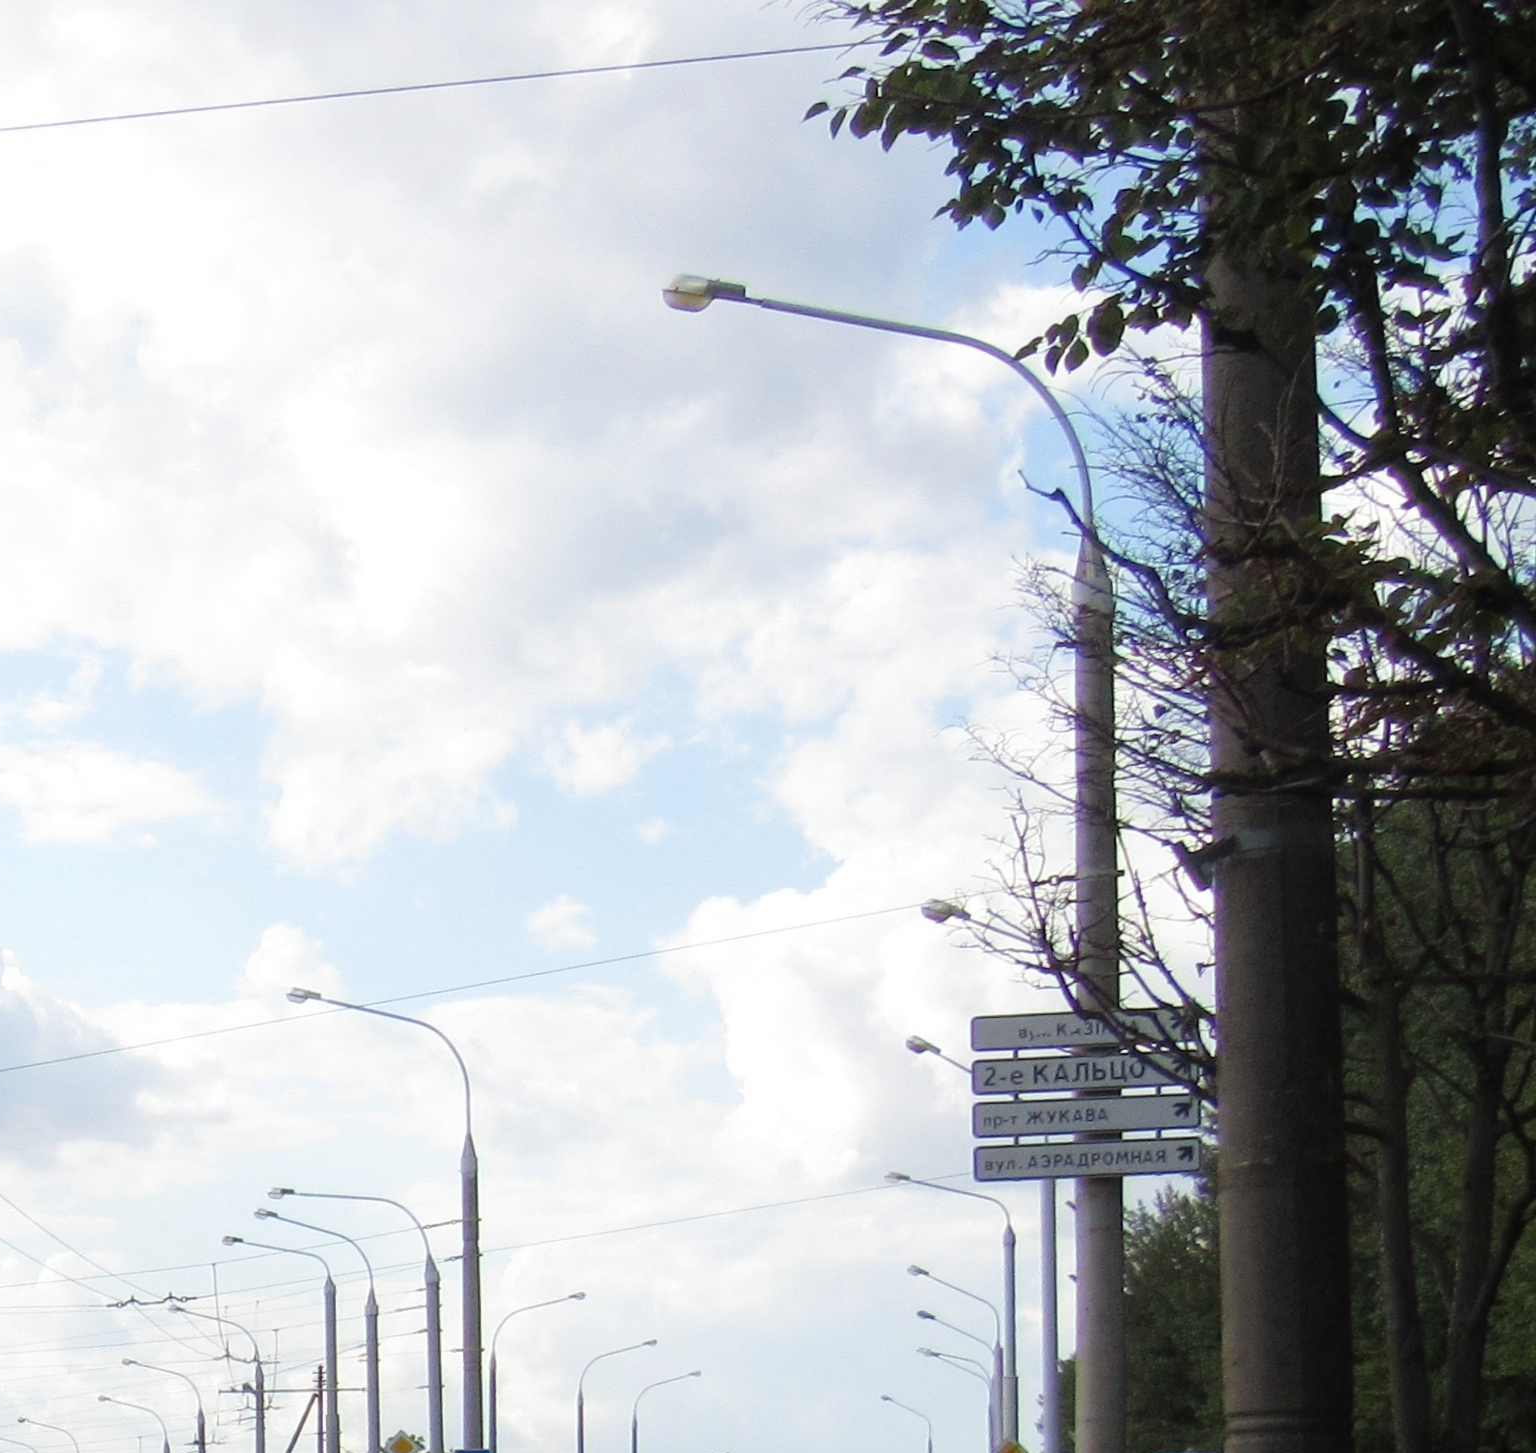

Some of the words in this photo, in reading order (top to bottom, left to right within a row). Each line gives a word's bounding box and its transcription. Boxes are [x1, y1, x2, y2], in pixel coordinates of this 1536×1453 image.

[983, 1066, 1023, 1086] 2-е
[1033, 1061, 1146, 1084] КАЛЬЦО
[984, 1115, 1018, 1129] пр-т
[1026, 1108, 1108, 1125] ЖУКАВА
[984, 1158, 1022, 1174] вул.
[1027, 1149, 1167, 1169] АЭРАДРОМНАЯ
